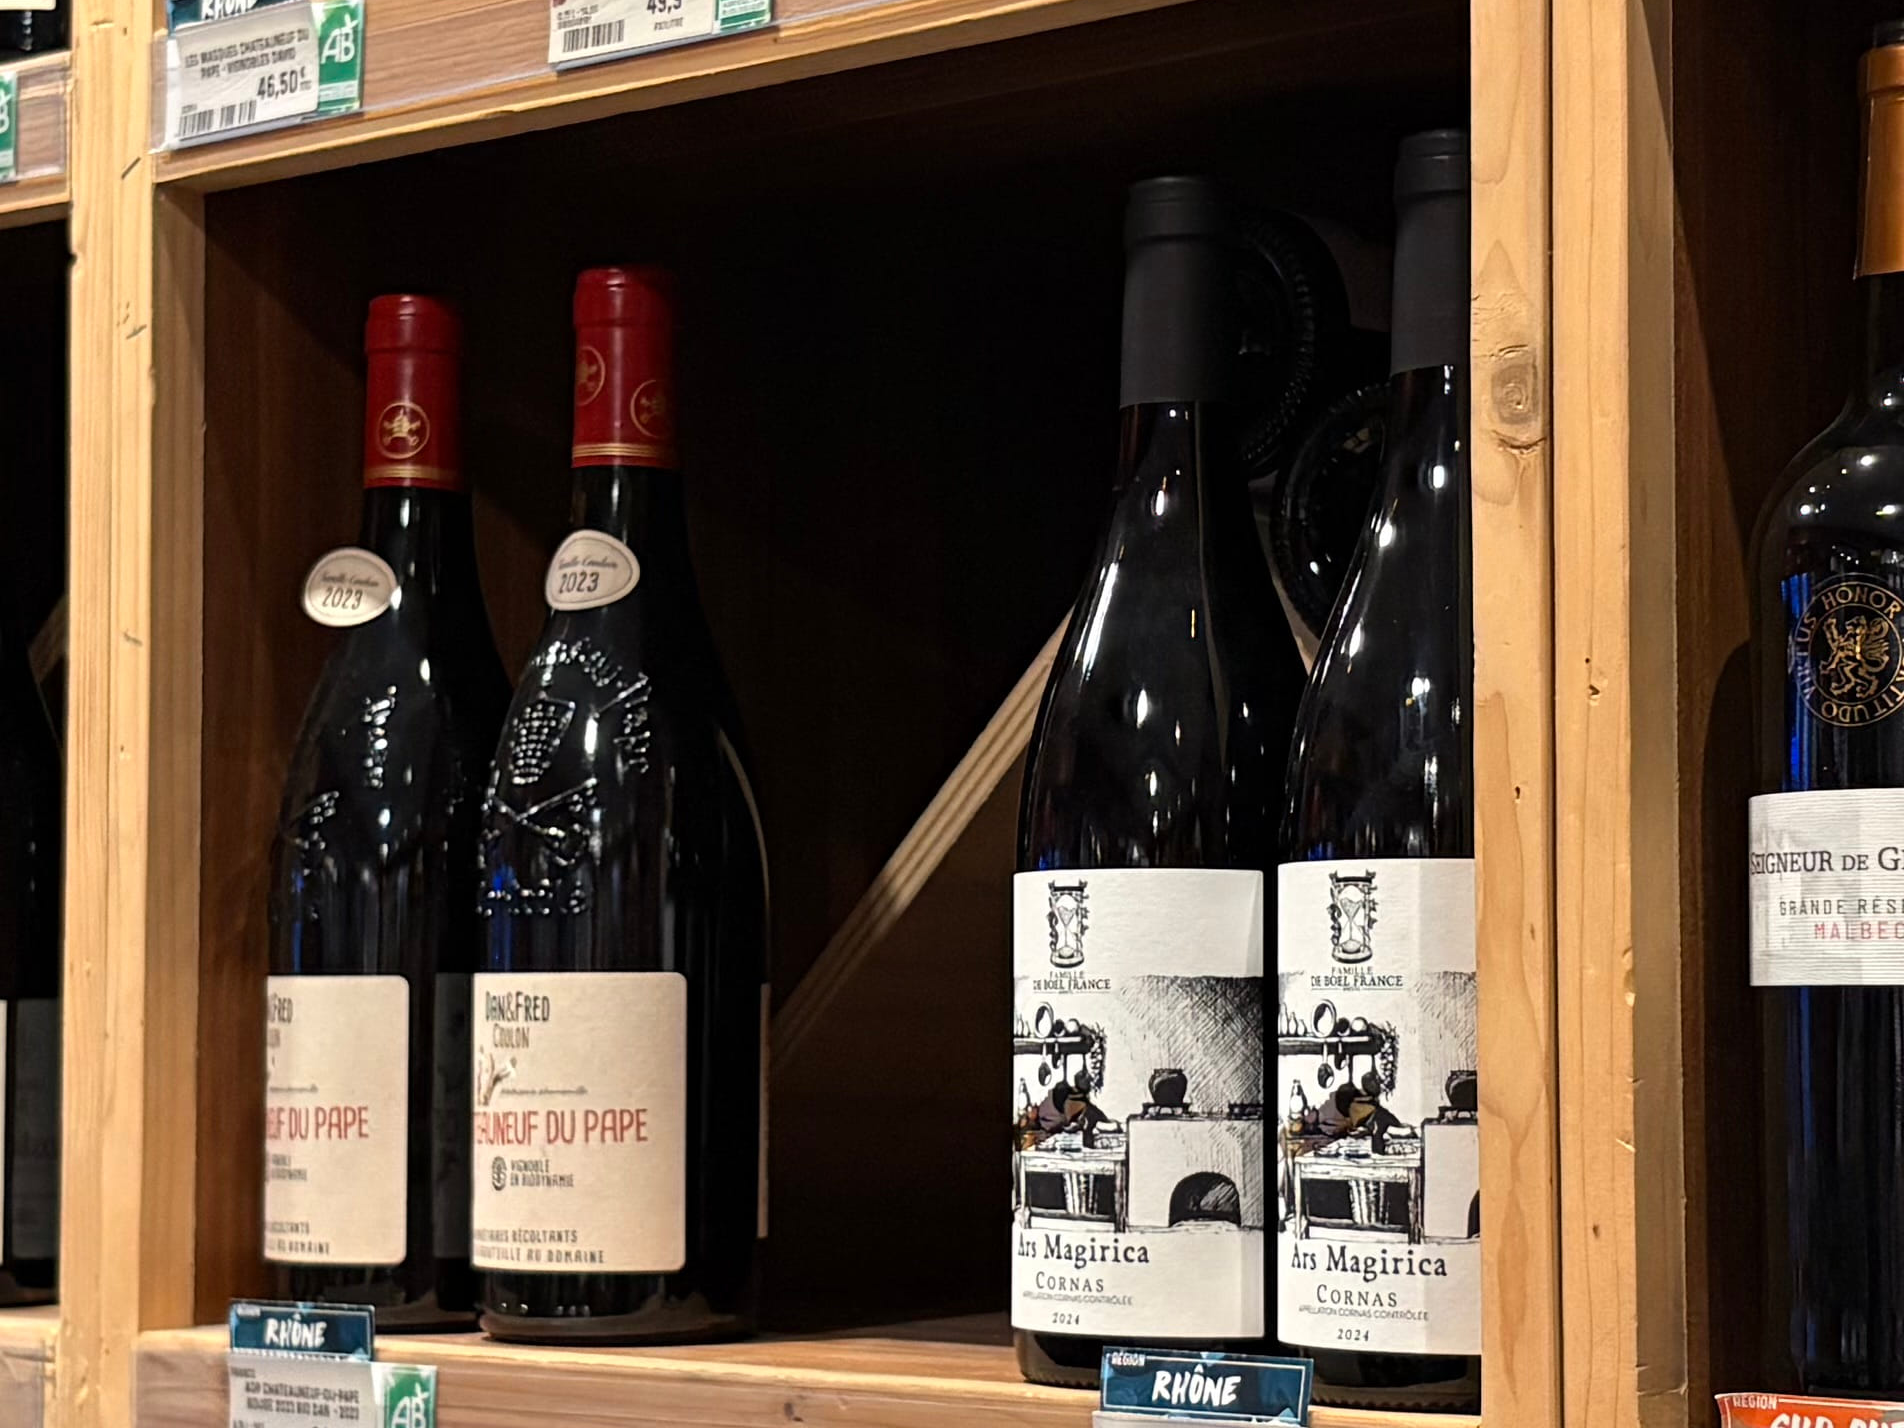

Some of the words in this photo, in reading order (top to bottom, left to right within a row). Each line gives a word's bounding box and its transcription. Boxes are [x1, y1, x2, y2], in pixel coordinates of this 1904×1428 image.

[321, 27, 356, 65] AB
[257, 69, 298, 100] 46,50
[322, 586, 363, 611] 2023
[558, 571, 599, 595] 2023
[1779, 898, 1845, 917] GRANDE
[1067, 977, 1112, 991] FRANCE
[1353, 973, 1404, 989] FRANCE
[315, 1105, 369, 1139] PAPE
[546, 1110, 576, 1144] DU
[583, 1108, 648, 1143] PAPE
[1044, 1233, 1150, 1269] Magirica
[1291, 1241, 1317, 1270] Ars
[1325, 1243, 1448, 1282] Magirica
[1036, 1272, 1104, 1293] CORNAS
[1316, 1284, 1398, 1308] CORNAS
[265, 1314, 327, 1348] RHÔNE
[1151, 1364, 1241, 1407] RHÔNE
